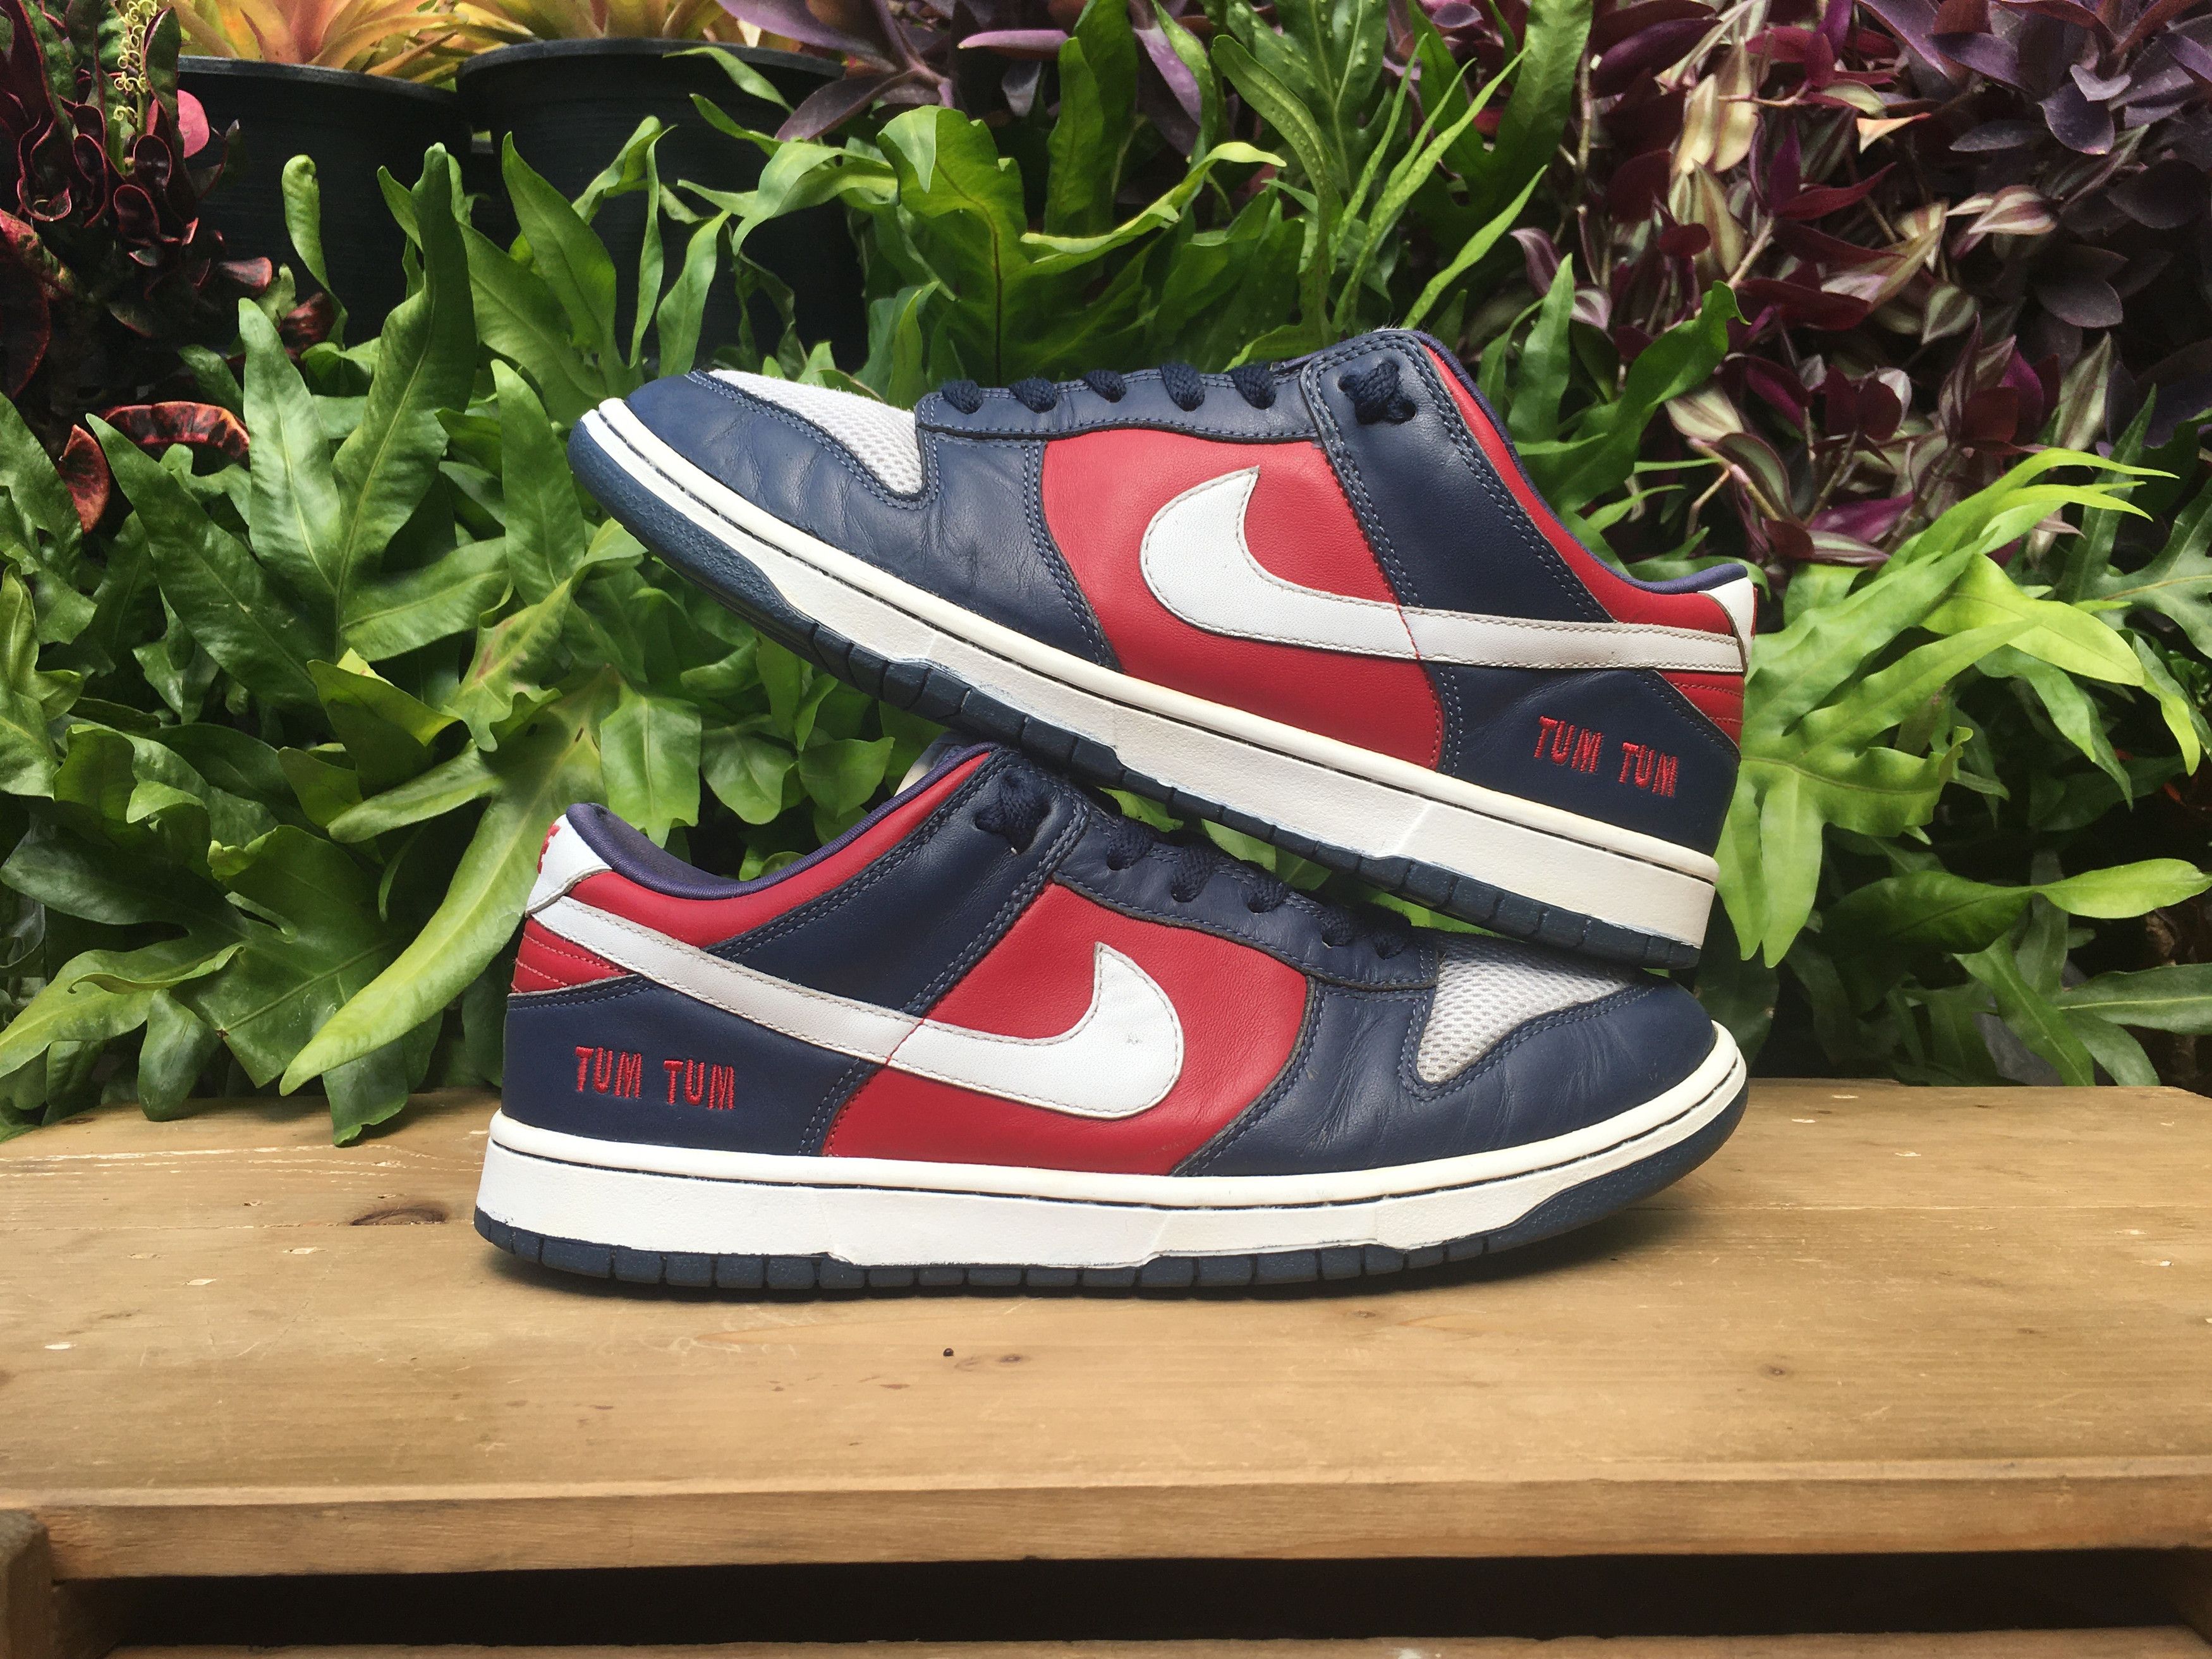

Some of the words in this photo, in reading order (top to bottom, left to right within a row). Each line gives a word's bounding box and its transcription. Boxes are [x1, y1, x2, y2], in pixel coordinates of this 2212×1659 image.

[1534, 715, 1603, 774] TUM
[1619, 741, 1679, 798] TUM
[574, 1045, 642, 1098] TUM
[664, 1059, 736, 1110] TUM
